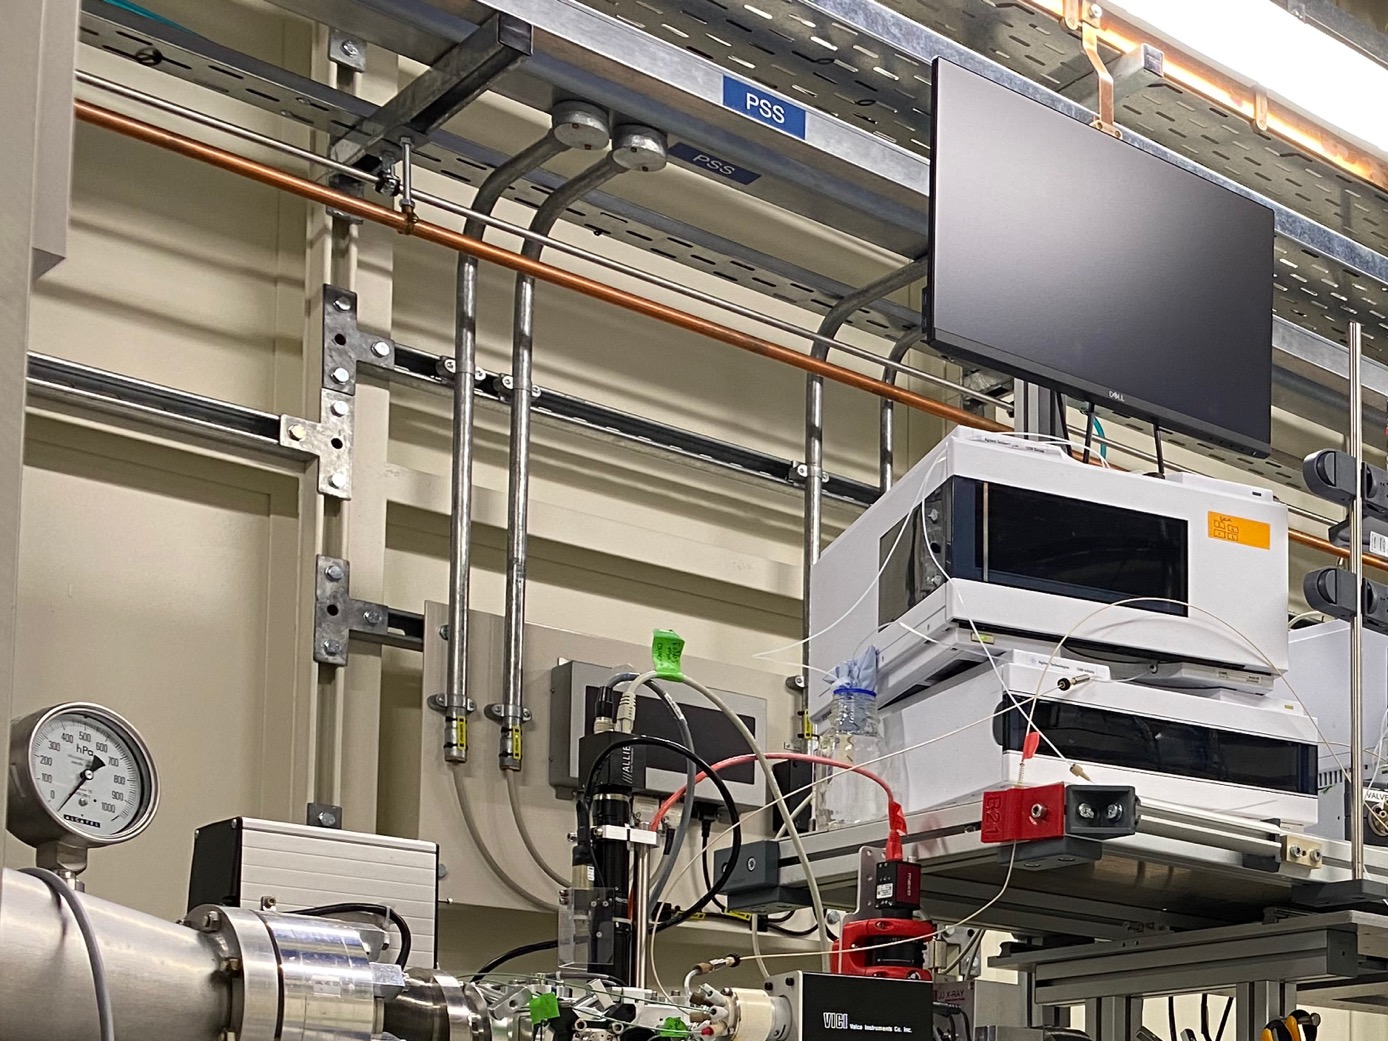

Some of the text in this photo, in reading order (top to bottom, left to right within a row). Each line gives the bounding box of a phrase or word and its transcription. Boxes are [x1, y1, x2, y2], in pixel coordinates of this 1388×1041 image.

[746, 92, 785, 123] PSS
[693, 154, 735, 174] PSS
[61, 732, 73, 743] 400
[79, 731, 91, 742] 500
[48, 740, 60, 751] 300
[76, 744, 94, 756] hPa
[96, 742, 108, 753] 600
[40, 755, 52, 766] 200
[108, 756, 119, 767] 700
[41, 772, 52, 783] 100
[114, 775, 125, 785] 800
[112, 791, 124, 801] 900
[101, 802, 115, 813] 1000
[823, 1012, 848, 1029] VICI
